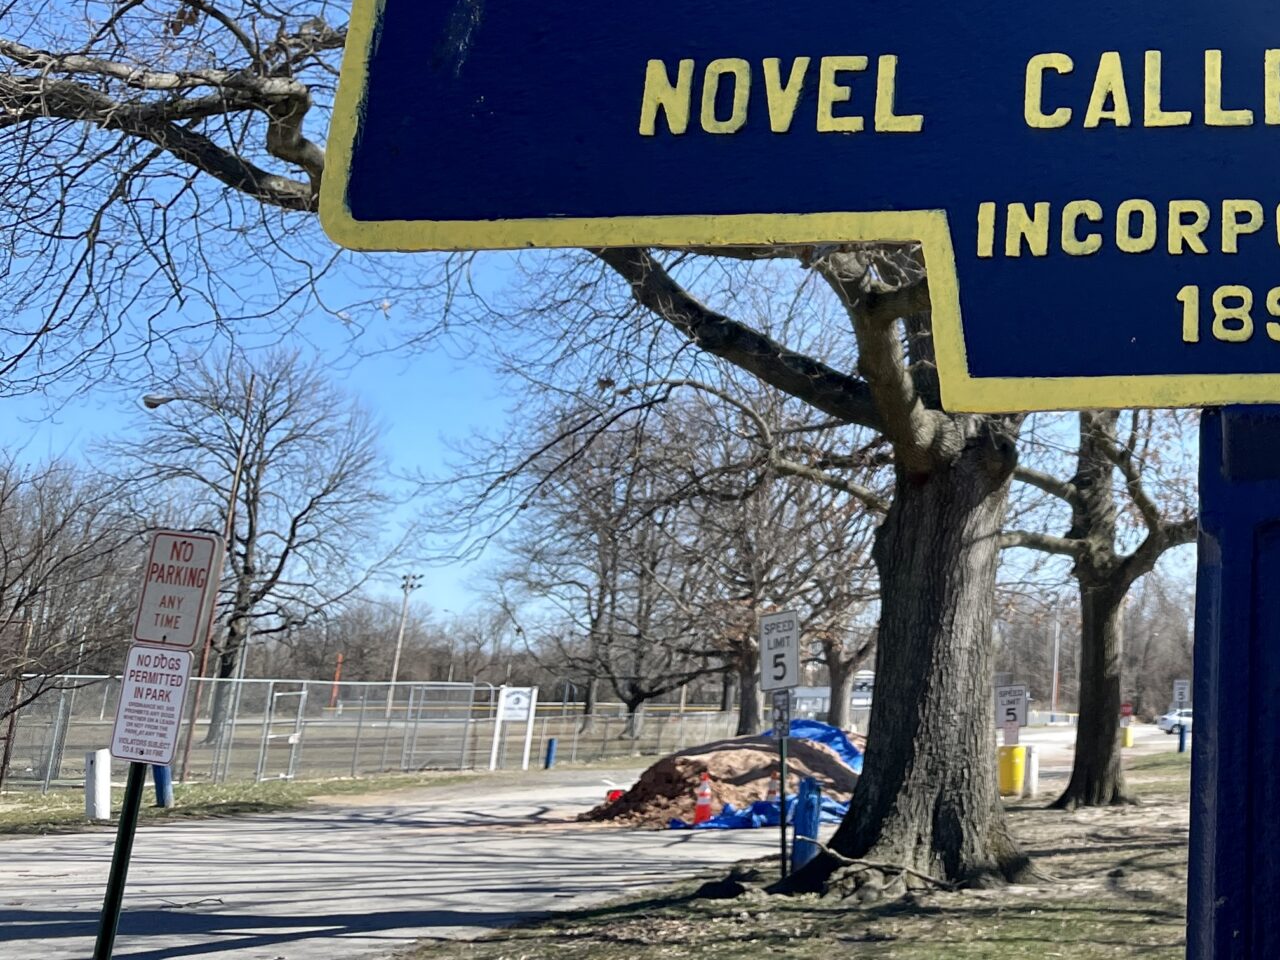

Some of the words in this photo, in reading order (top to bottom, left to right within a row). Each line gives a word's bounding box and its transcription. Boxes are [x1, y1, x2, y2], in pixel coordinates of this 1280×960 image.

[638, 53, 924, 136] NOVEL
[170, 541, 194, 562] NO
[149, 563, 206, 588] PARKING
[159, 595, 184, 610] ANY
[154, 613, 182, 629] TIME
[764, 620, 794, 635] SPEED
[767, 636, 791, 650] LIMIT
[137, 654, 151, 667] NO
[153, 655, 181, 670] DOGS
[773, 653, 787, 681] 5
[129, 670, 183, 687] PERMITTED
[134, 687, 144, 698] IN
[145, 688, 172, 701] PARK
[1006, 708, 1017, 722] 5
